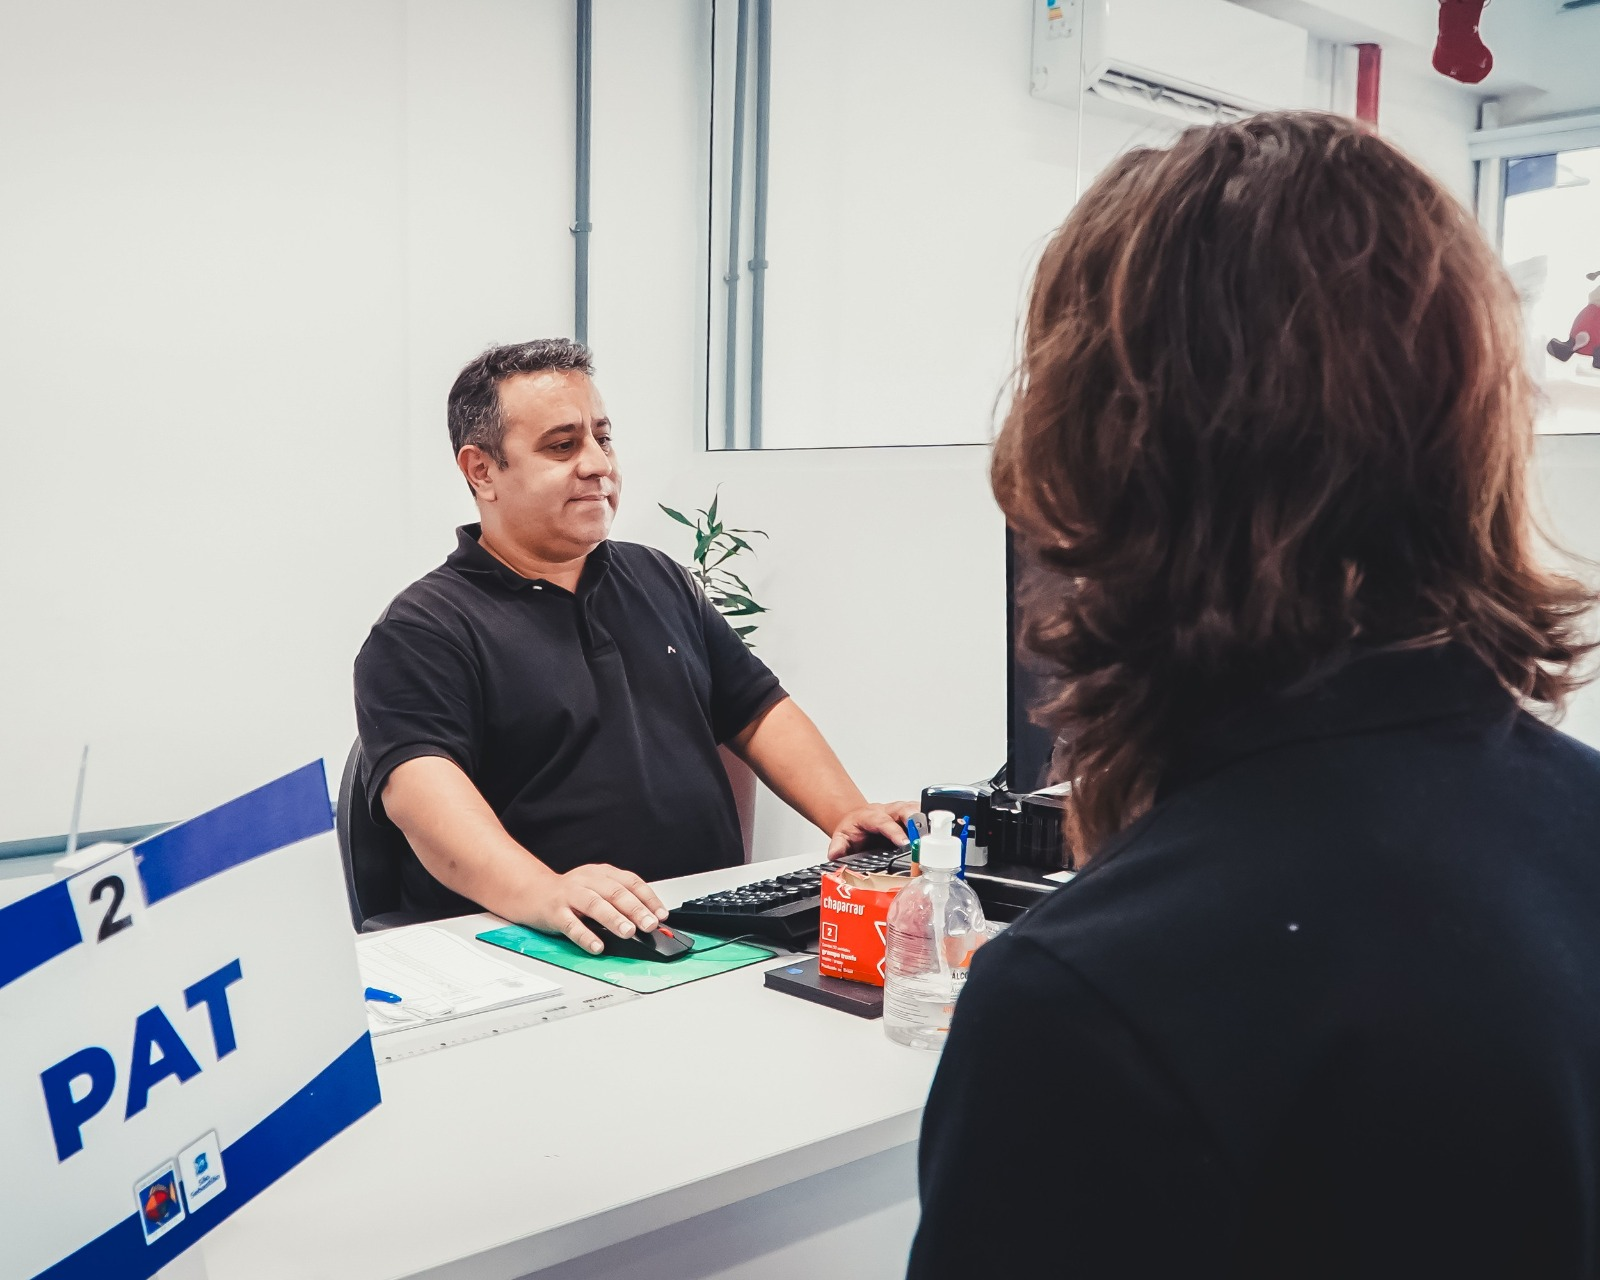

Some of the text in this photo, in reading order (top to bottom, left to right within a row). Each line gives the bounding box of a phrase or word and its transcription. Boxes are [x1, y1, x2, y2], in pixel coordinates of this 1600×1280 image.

[89, 874, 133, 944] 2
[827, 927, 833, 937] 2
[39, 957, 244, 1165] PAT
